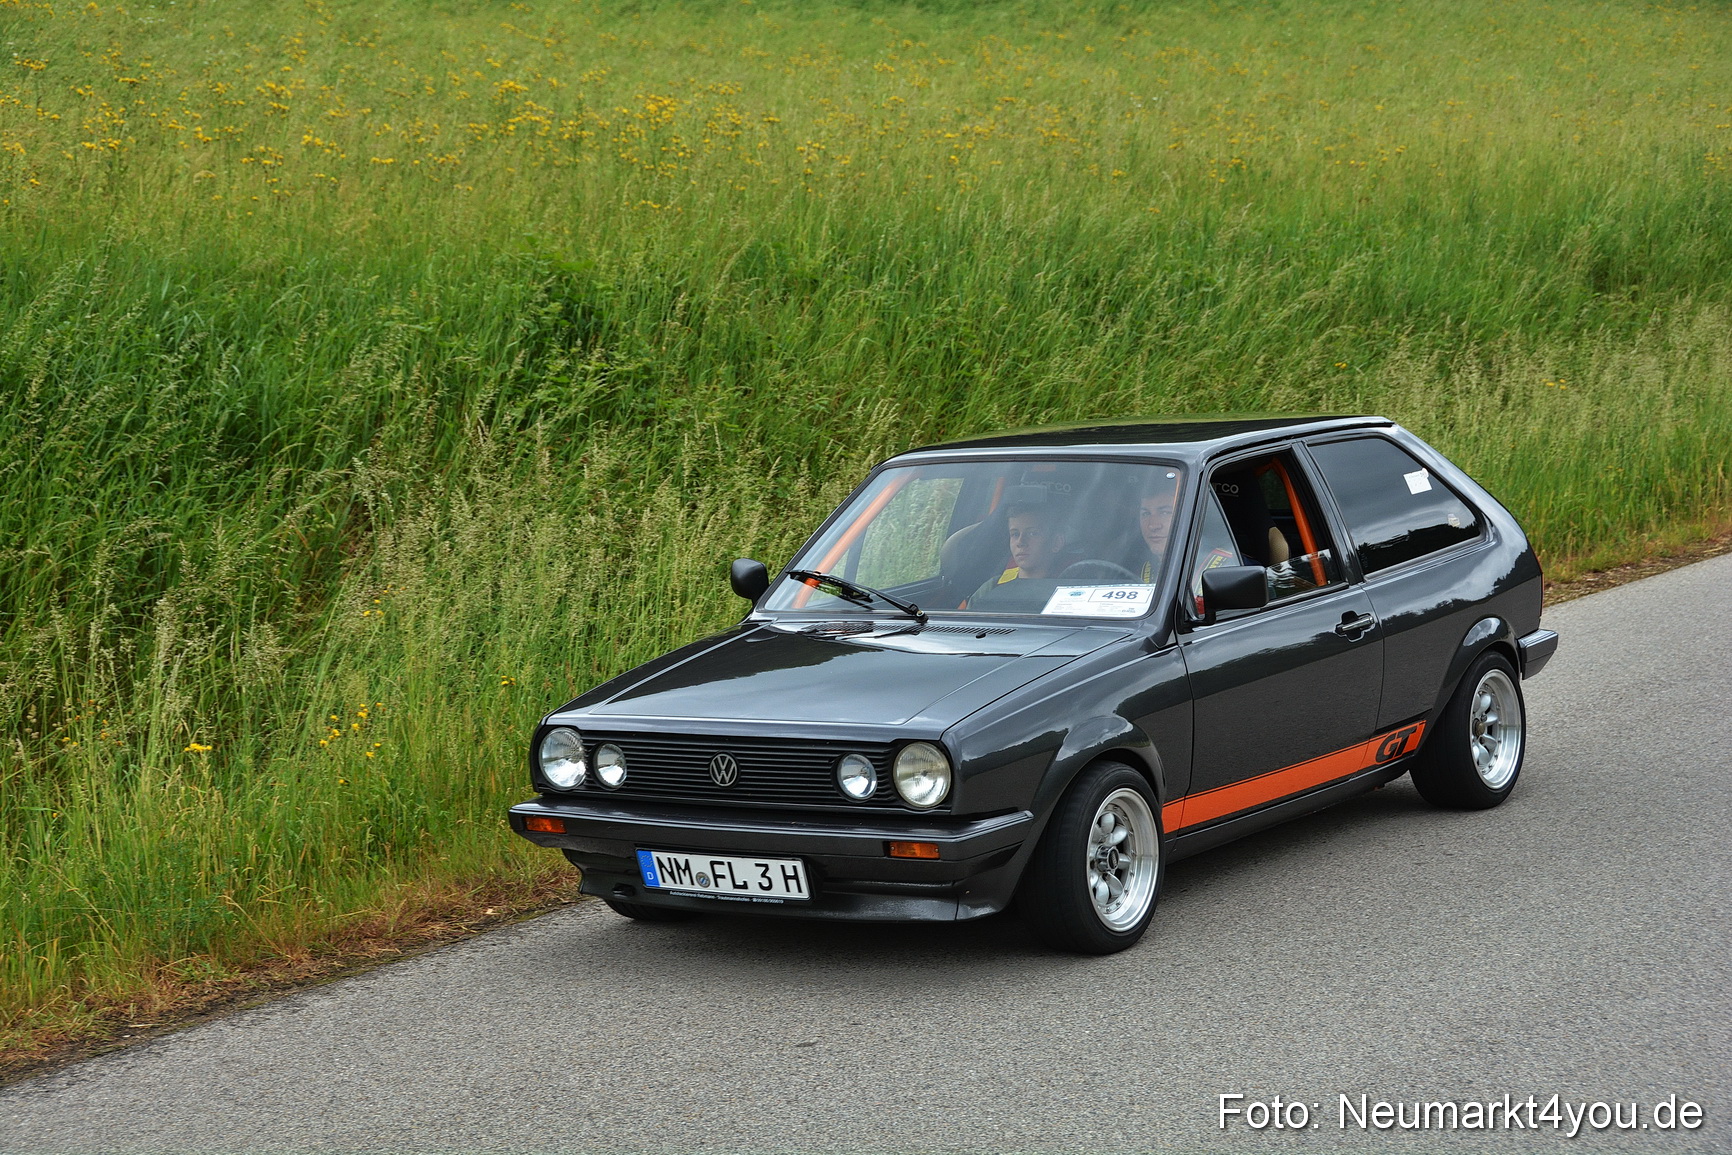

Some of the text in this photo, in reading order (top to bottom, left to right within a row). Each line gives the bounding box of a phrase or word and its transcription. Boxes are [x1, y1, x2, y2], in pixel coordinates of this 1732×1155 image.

[1102, 590, 1139, 600] 498
[1376, 726, 1417, 763] GT
[647, 871, 655, 881] D
[656, 856, 803, 893] NM FL 3 H
